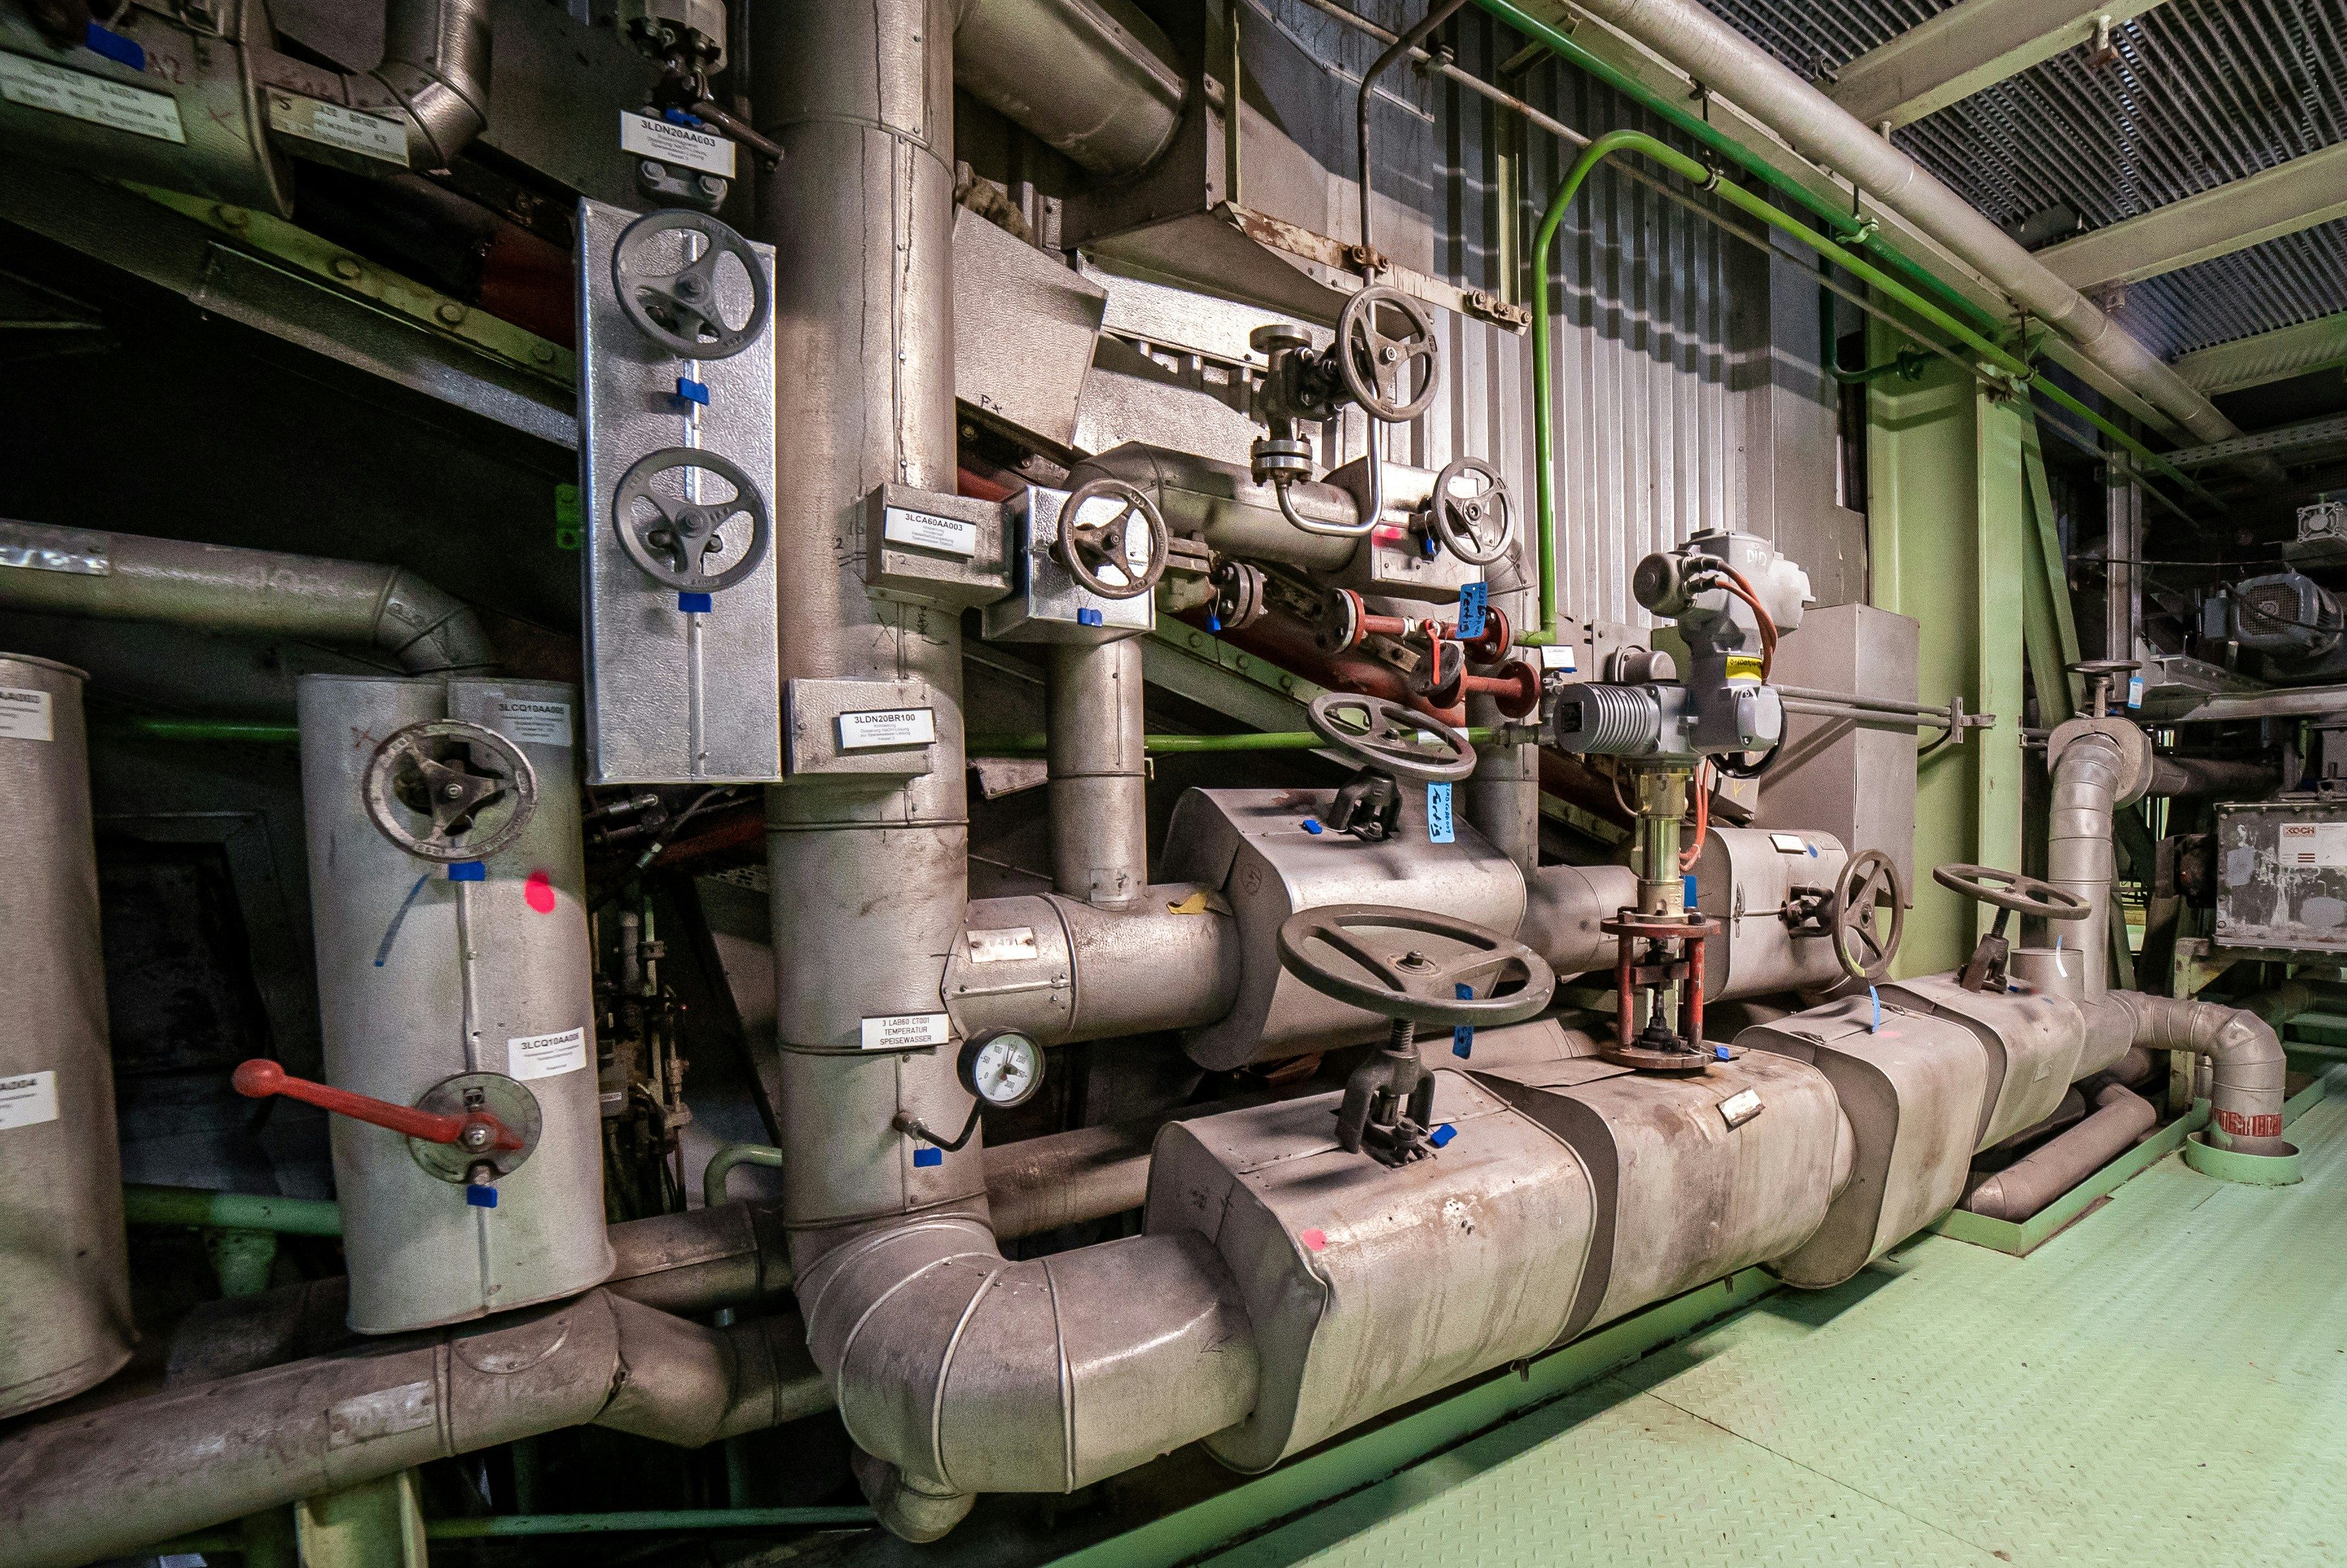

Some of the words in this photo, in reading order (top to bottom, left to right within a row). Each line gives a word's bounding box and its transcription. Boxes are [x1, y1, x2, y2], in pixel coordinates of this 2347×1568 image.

[641, 120, 716, 146] 3LDN20AA003
[905, 513, 963, 531] 3LCA60AA003
[854, 714, 916, 724] 3LDN20BR100
[889, 1018, 909, 1027] LAB60
[885, 1027, 927, 1036] TEMPERATUR
[880, 1035, 932, 1045] SPEISEWASSER
